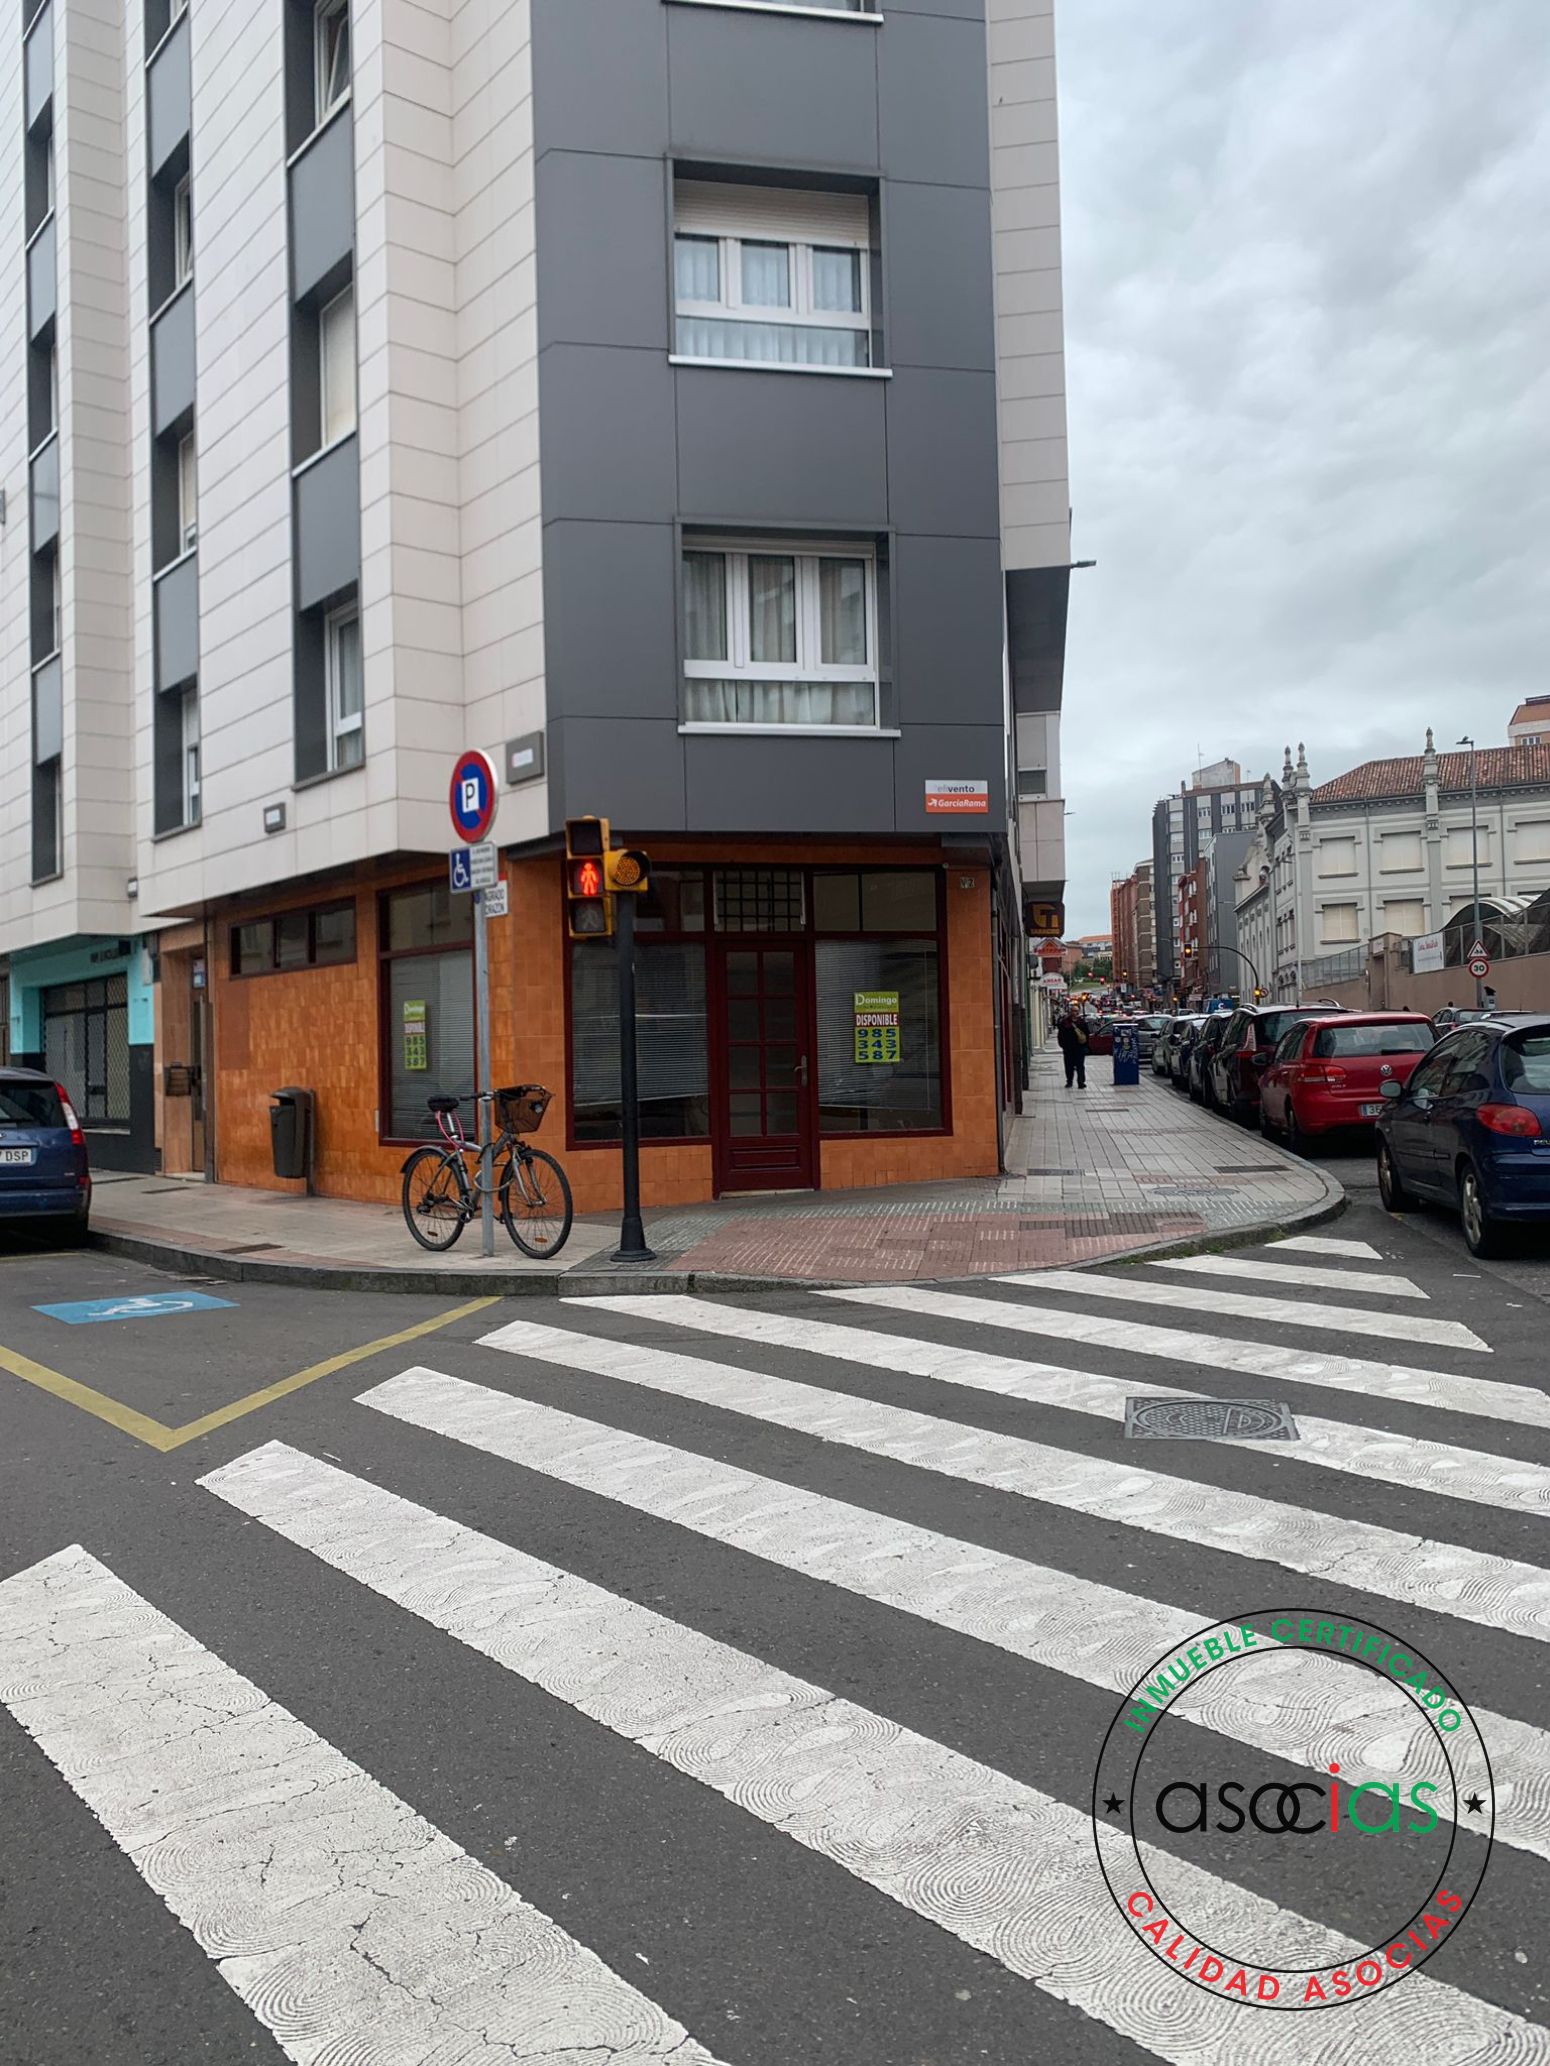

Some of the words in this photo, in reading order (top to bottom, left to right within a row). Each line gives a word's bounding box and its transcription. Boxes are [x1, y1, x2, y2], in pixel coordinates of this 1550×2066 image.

[465, 783, 476, 809] P
[1473, 964, 1485, 972] 30
[855, 994, 897, 1006] Domingo
[856, 1014, 898, 1026] DISPONIBLE
[857, 1028, 897, 1038] 985
[857, 1039, 897, 1049] 343
[858, 1050, 897, 1060] 587
[5, 1150, 29, 1162] DSP
